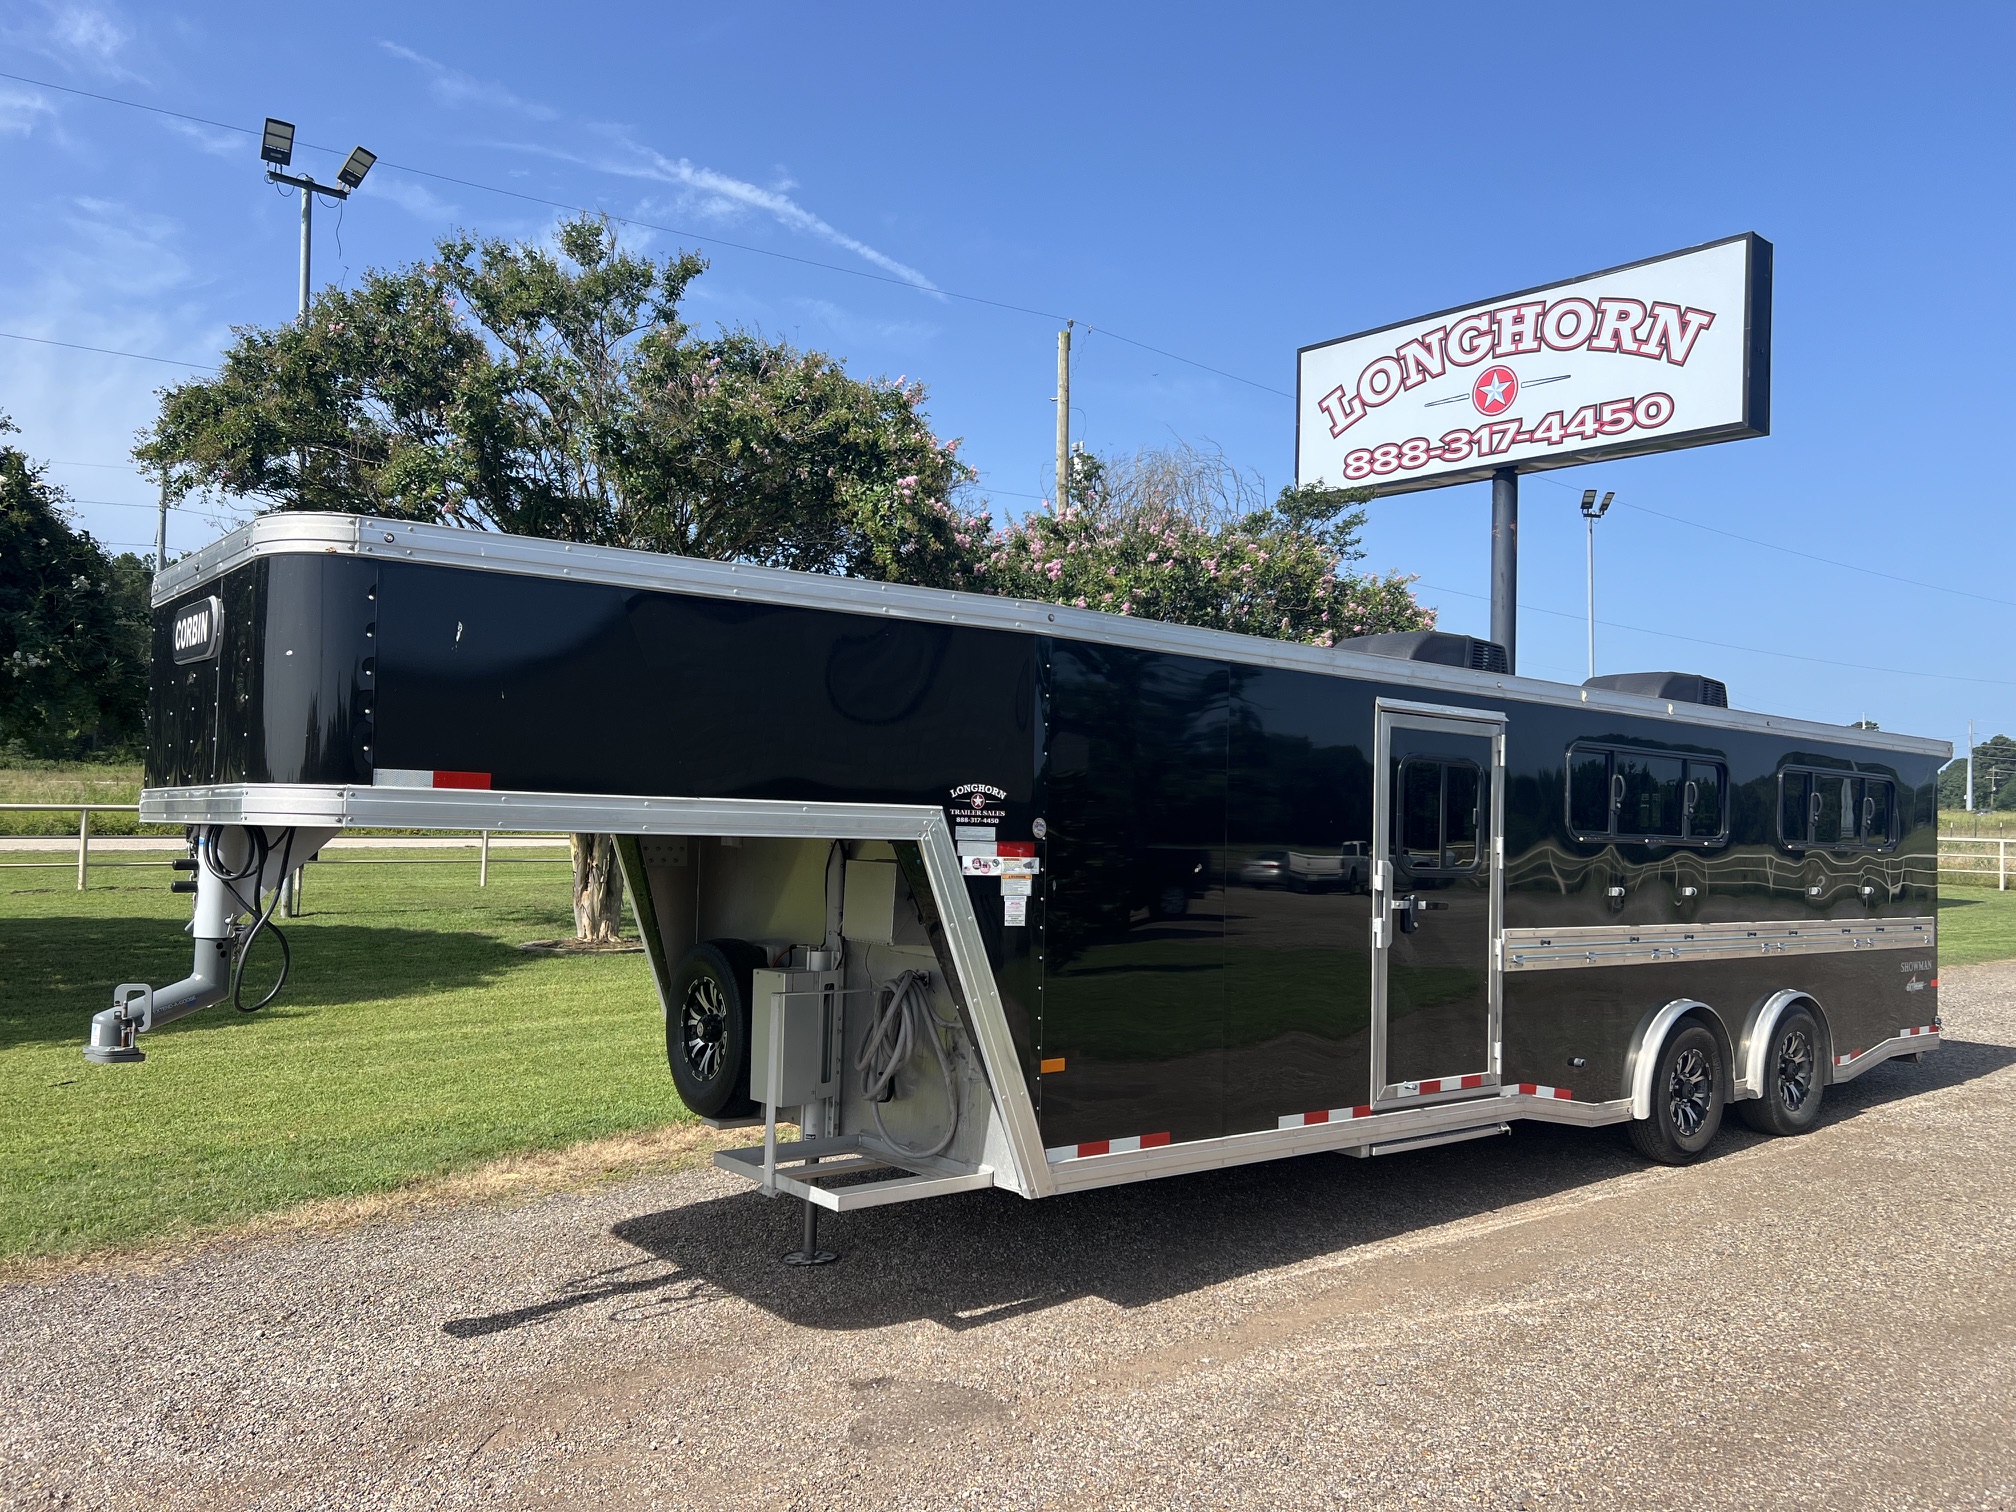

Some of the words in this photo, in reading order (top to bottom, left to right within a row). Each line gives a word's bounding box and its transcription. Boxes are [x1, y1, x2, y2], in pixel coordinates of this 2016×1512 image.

[1318, 297, 1716, 439] LONGHORN
[1343, 393, 1675, 480] 888-317-4450
[175, 610, 209, 651] CORBIN
[949, 783, 1007, 800] LONGHORN
[1900, 960, 1932, 972] SHOWMAN
